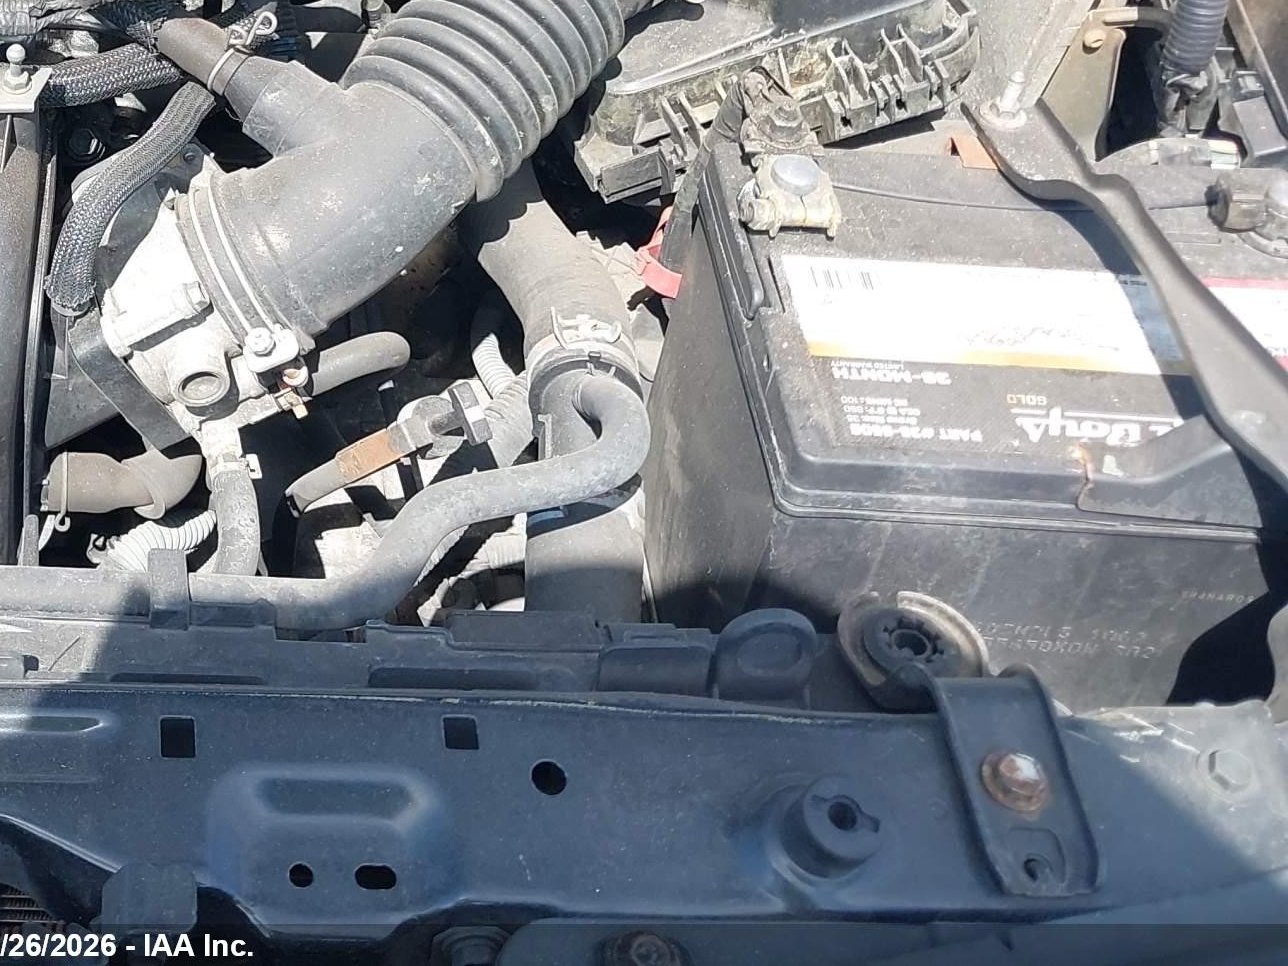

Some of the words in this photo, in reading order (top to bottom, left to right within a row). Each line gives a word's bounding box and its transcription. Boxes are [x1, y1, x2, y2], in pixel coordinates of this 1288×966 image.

[841, 395, 859, 404] 100
[1006, 394, 1047, 406] GOLD
[939, 427, 983, 443] PART
